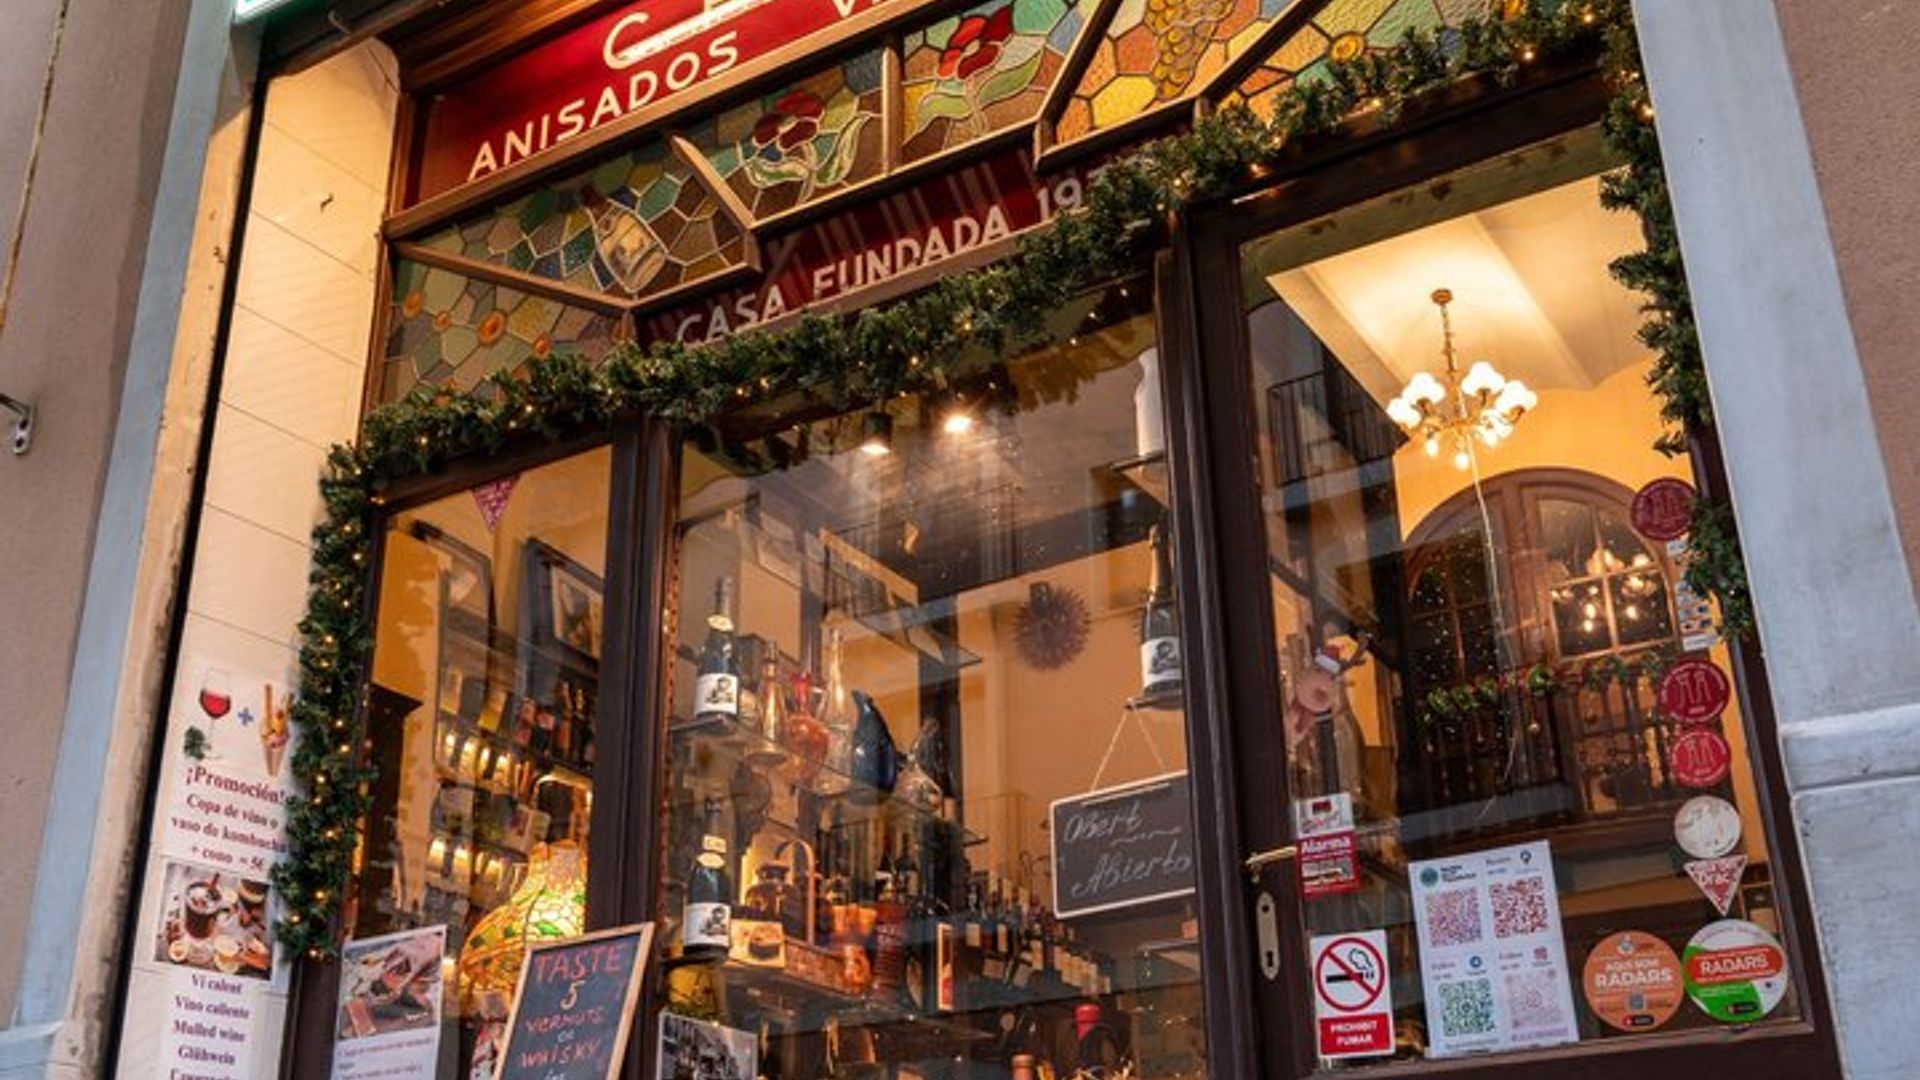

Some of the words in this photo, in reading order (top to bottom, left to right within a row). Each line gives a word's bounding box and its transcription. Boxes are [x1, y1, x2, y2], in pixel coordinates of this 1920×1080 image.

[466, 30, 740, 181] ANISADOS
[675, 282, 787, 345] CASA
[812, 205, 1010, 298] FUNDADA
[186, 765, 286, 805] ¡Promoción!
[186, 793, 221, 815] Copa
[224, 804, 239, 819] de
[242, 808, 268, 825] vino
[171, 816, 201, 833] vaso
[203, 822, 220, 838] de
[533, 945, 623, 984] TASTE
[1594, 966, 1674, 990] RADARS
[1698, 953, 1770, 976] RADARS
[174, 995, 204, 1013] Vino
[205, 1002, 250, 1020] caliente
[559, 980, 587, 1011] 5
[172, 1019, 218, 1039] Mulled
[219, 1025, 246, 1043] wine
[177, 1045, 236, 1066] Glühwein
